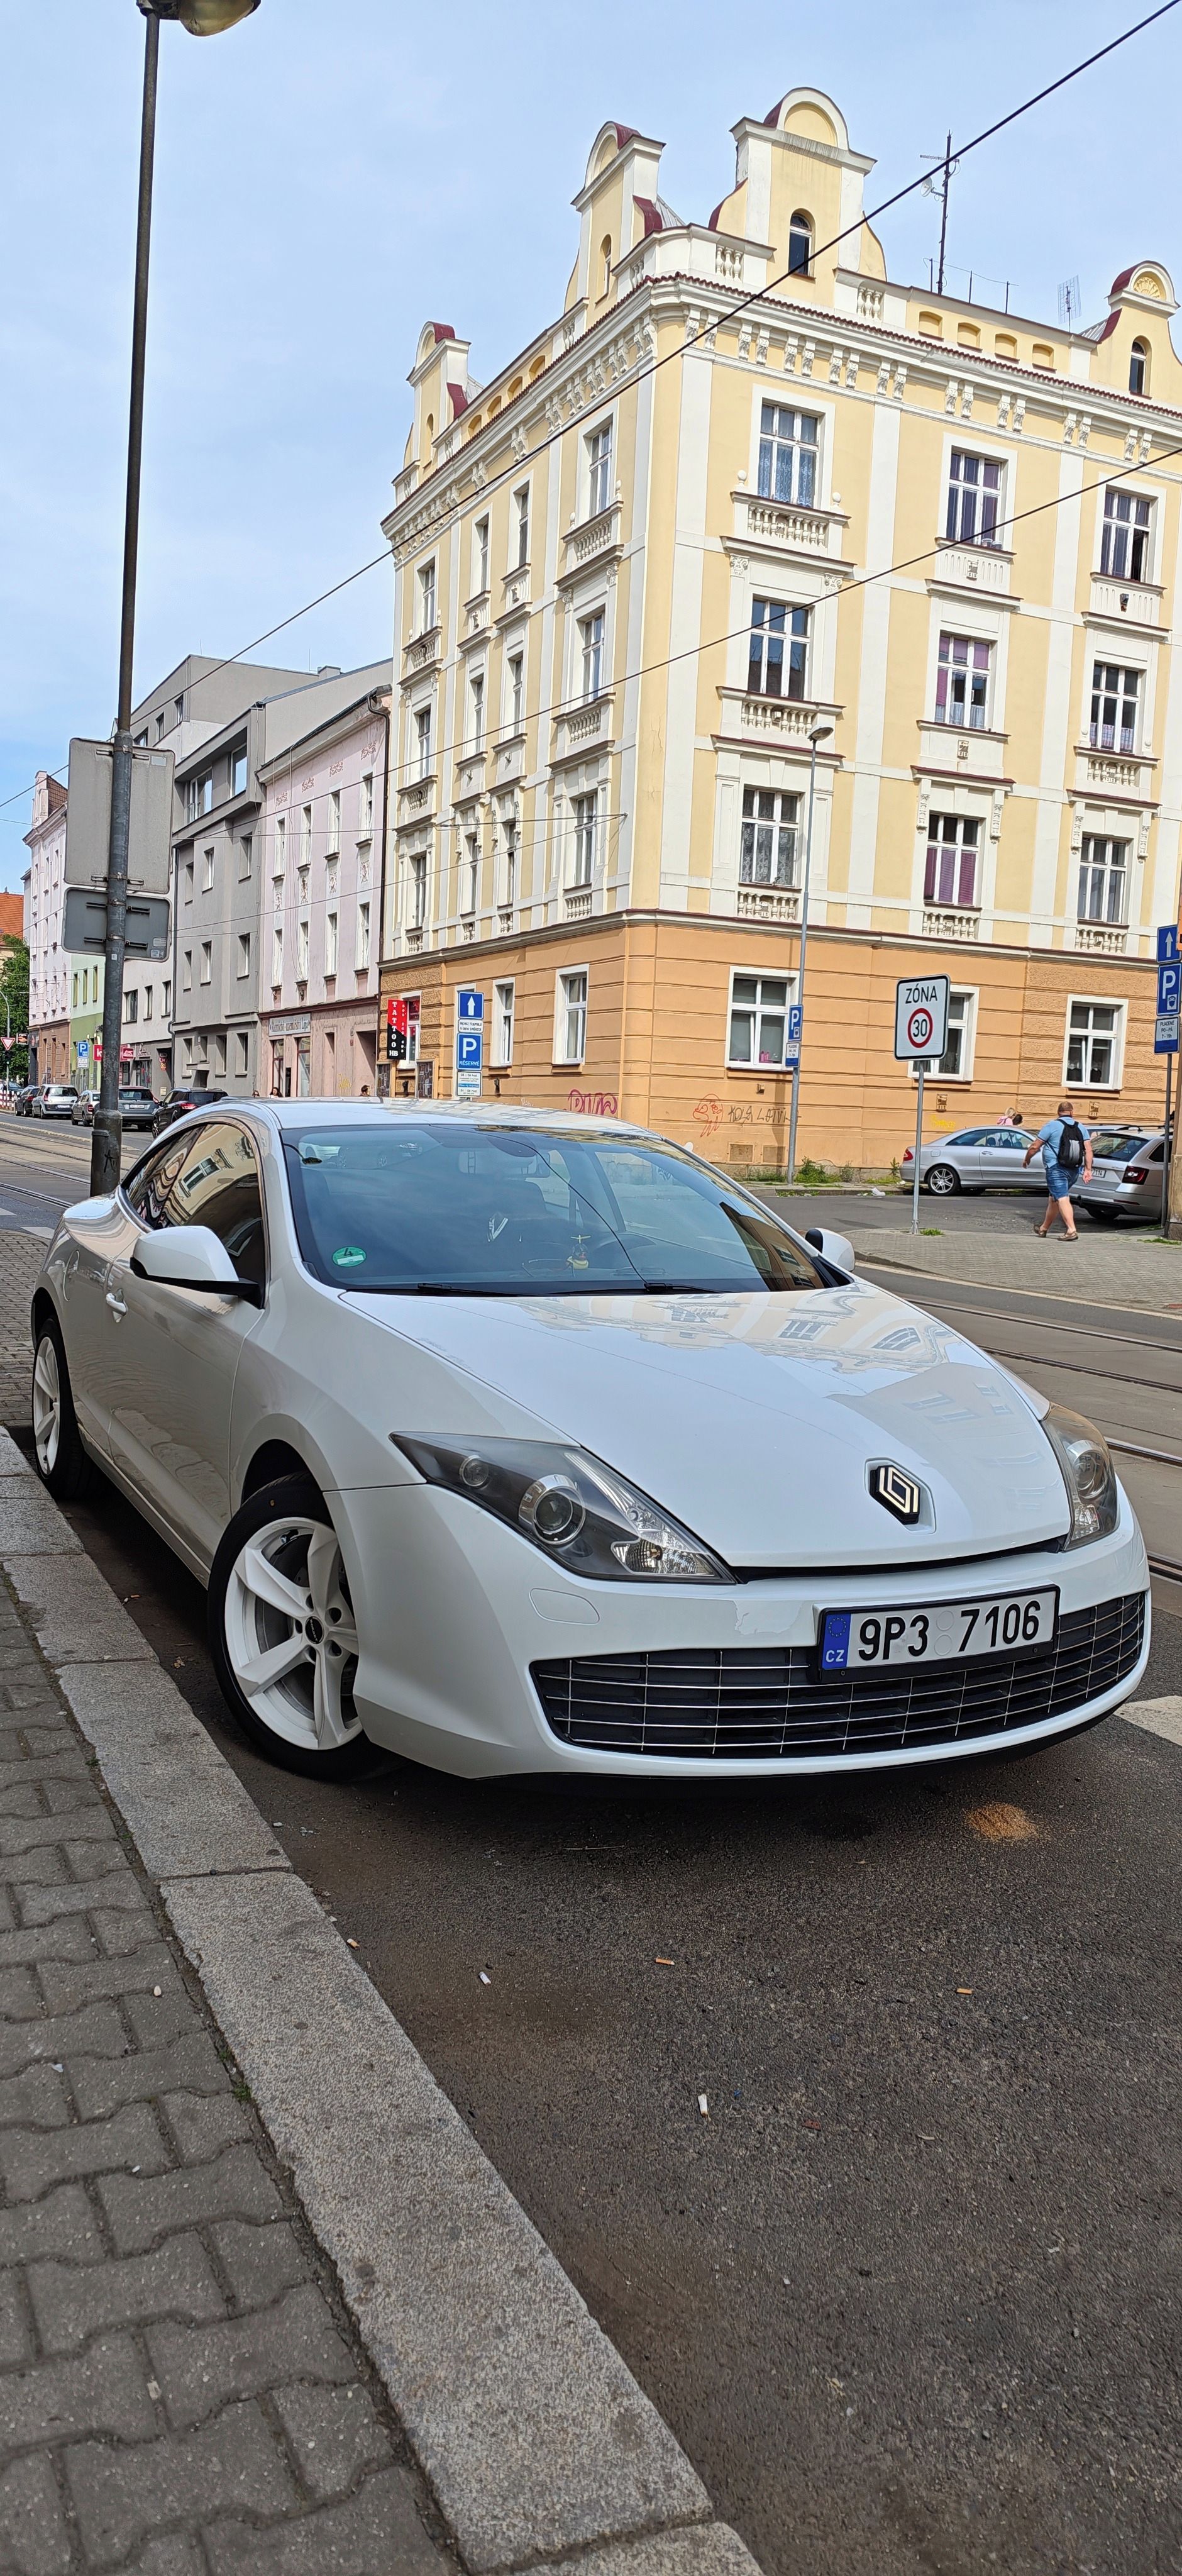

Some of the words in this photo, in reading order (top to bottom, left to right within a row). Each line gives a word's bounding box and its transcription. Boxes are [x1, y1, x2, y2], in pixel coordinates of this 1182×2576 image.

[905, 983, 937, 1004] ZÓNA
[1163, 970, 1176, 999] P
[791, 1009, 799, 1030] P
[913, 1018, 927, 1037] 30
[80, 1044, 87, 1053] P
[463, 1038, 477, 1058] P
[344, 1248, 353, 1257] 4
[858, 1614, 929, 1662] 9P3
[958, 1600, 1041, 1652] 7106
[826, 1650, 844, 1663] CZ
